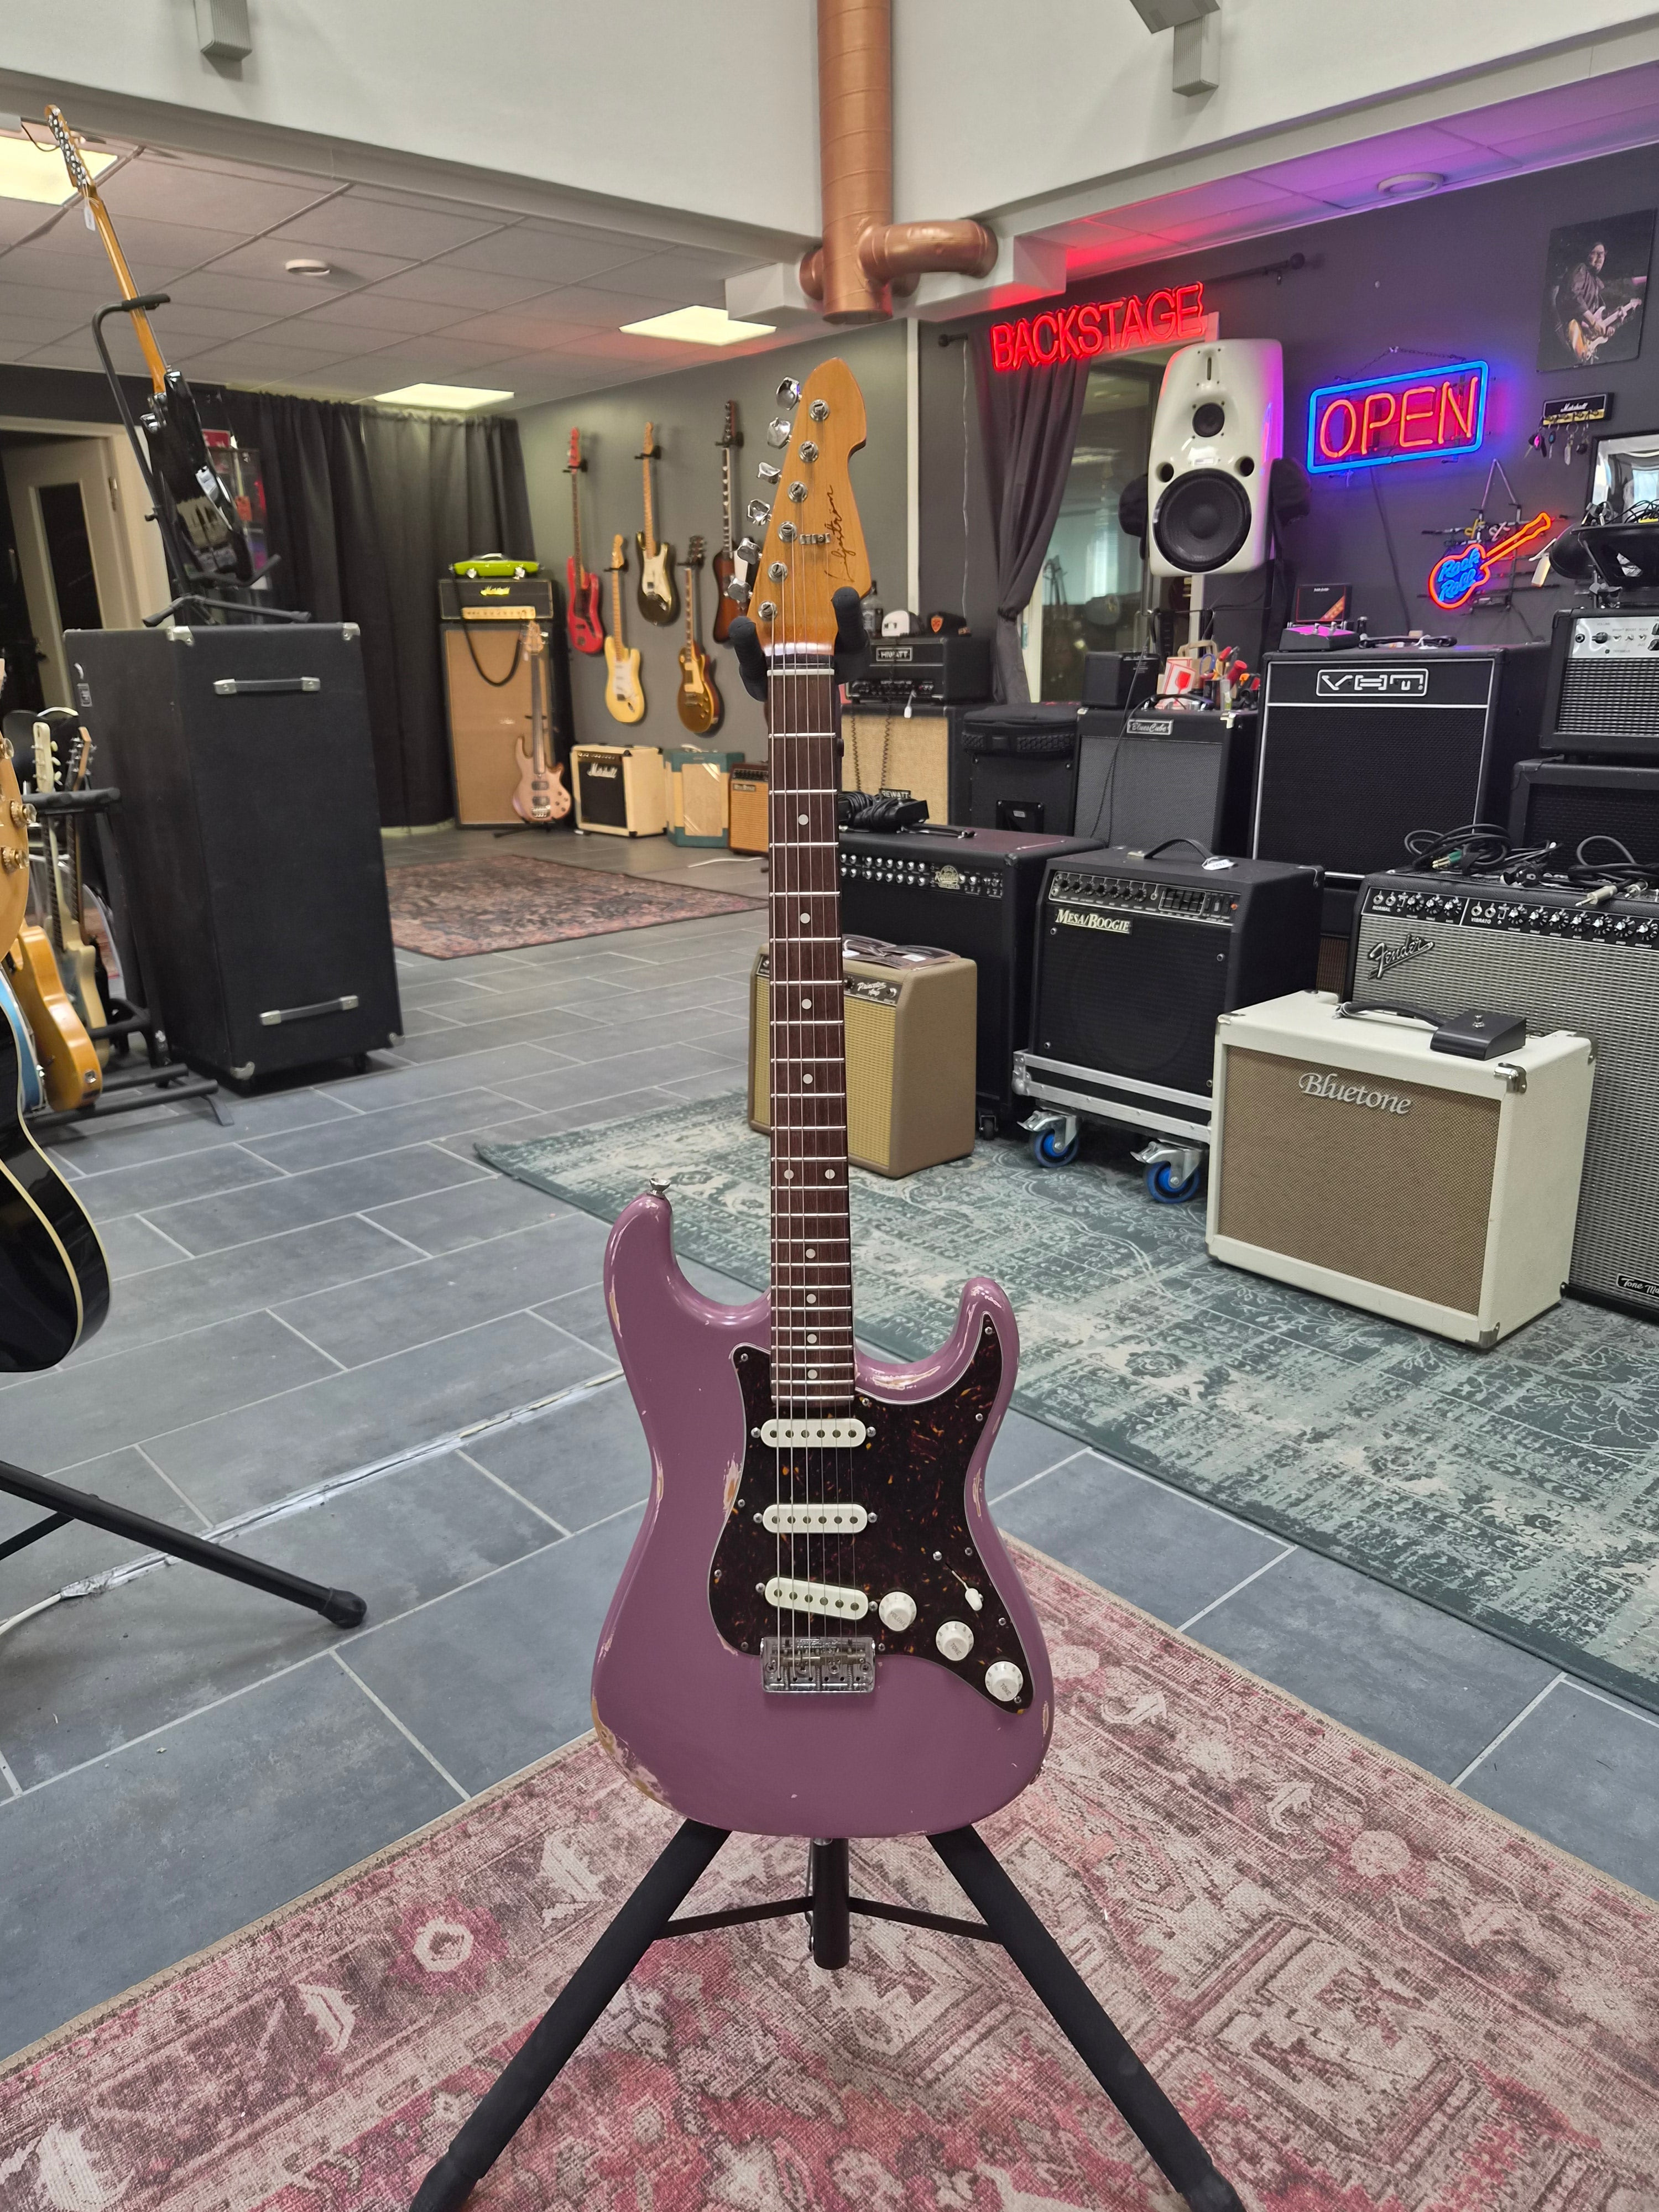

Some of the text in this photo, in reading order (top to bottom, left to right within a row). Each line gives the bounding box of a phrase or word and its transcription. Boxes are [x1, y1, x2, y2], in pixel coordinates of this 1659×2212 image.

[992, 283, 1204, 370] BACKSTAGE
[1320, 377, 1479, 458] OPEN
[1321, 674, 1424, 691] VHT
[1368, 933, 1434, 979] Fender
[1299, 1072, 1411, 1114] Bluetone
[1621, 1277, 1644, 1289] Tone
[890, 1610, 907, 1629] VOLUME
[950, 1642, 962, 1656] TONE
[1000, 1682, 1012, 1696] TONE
